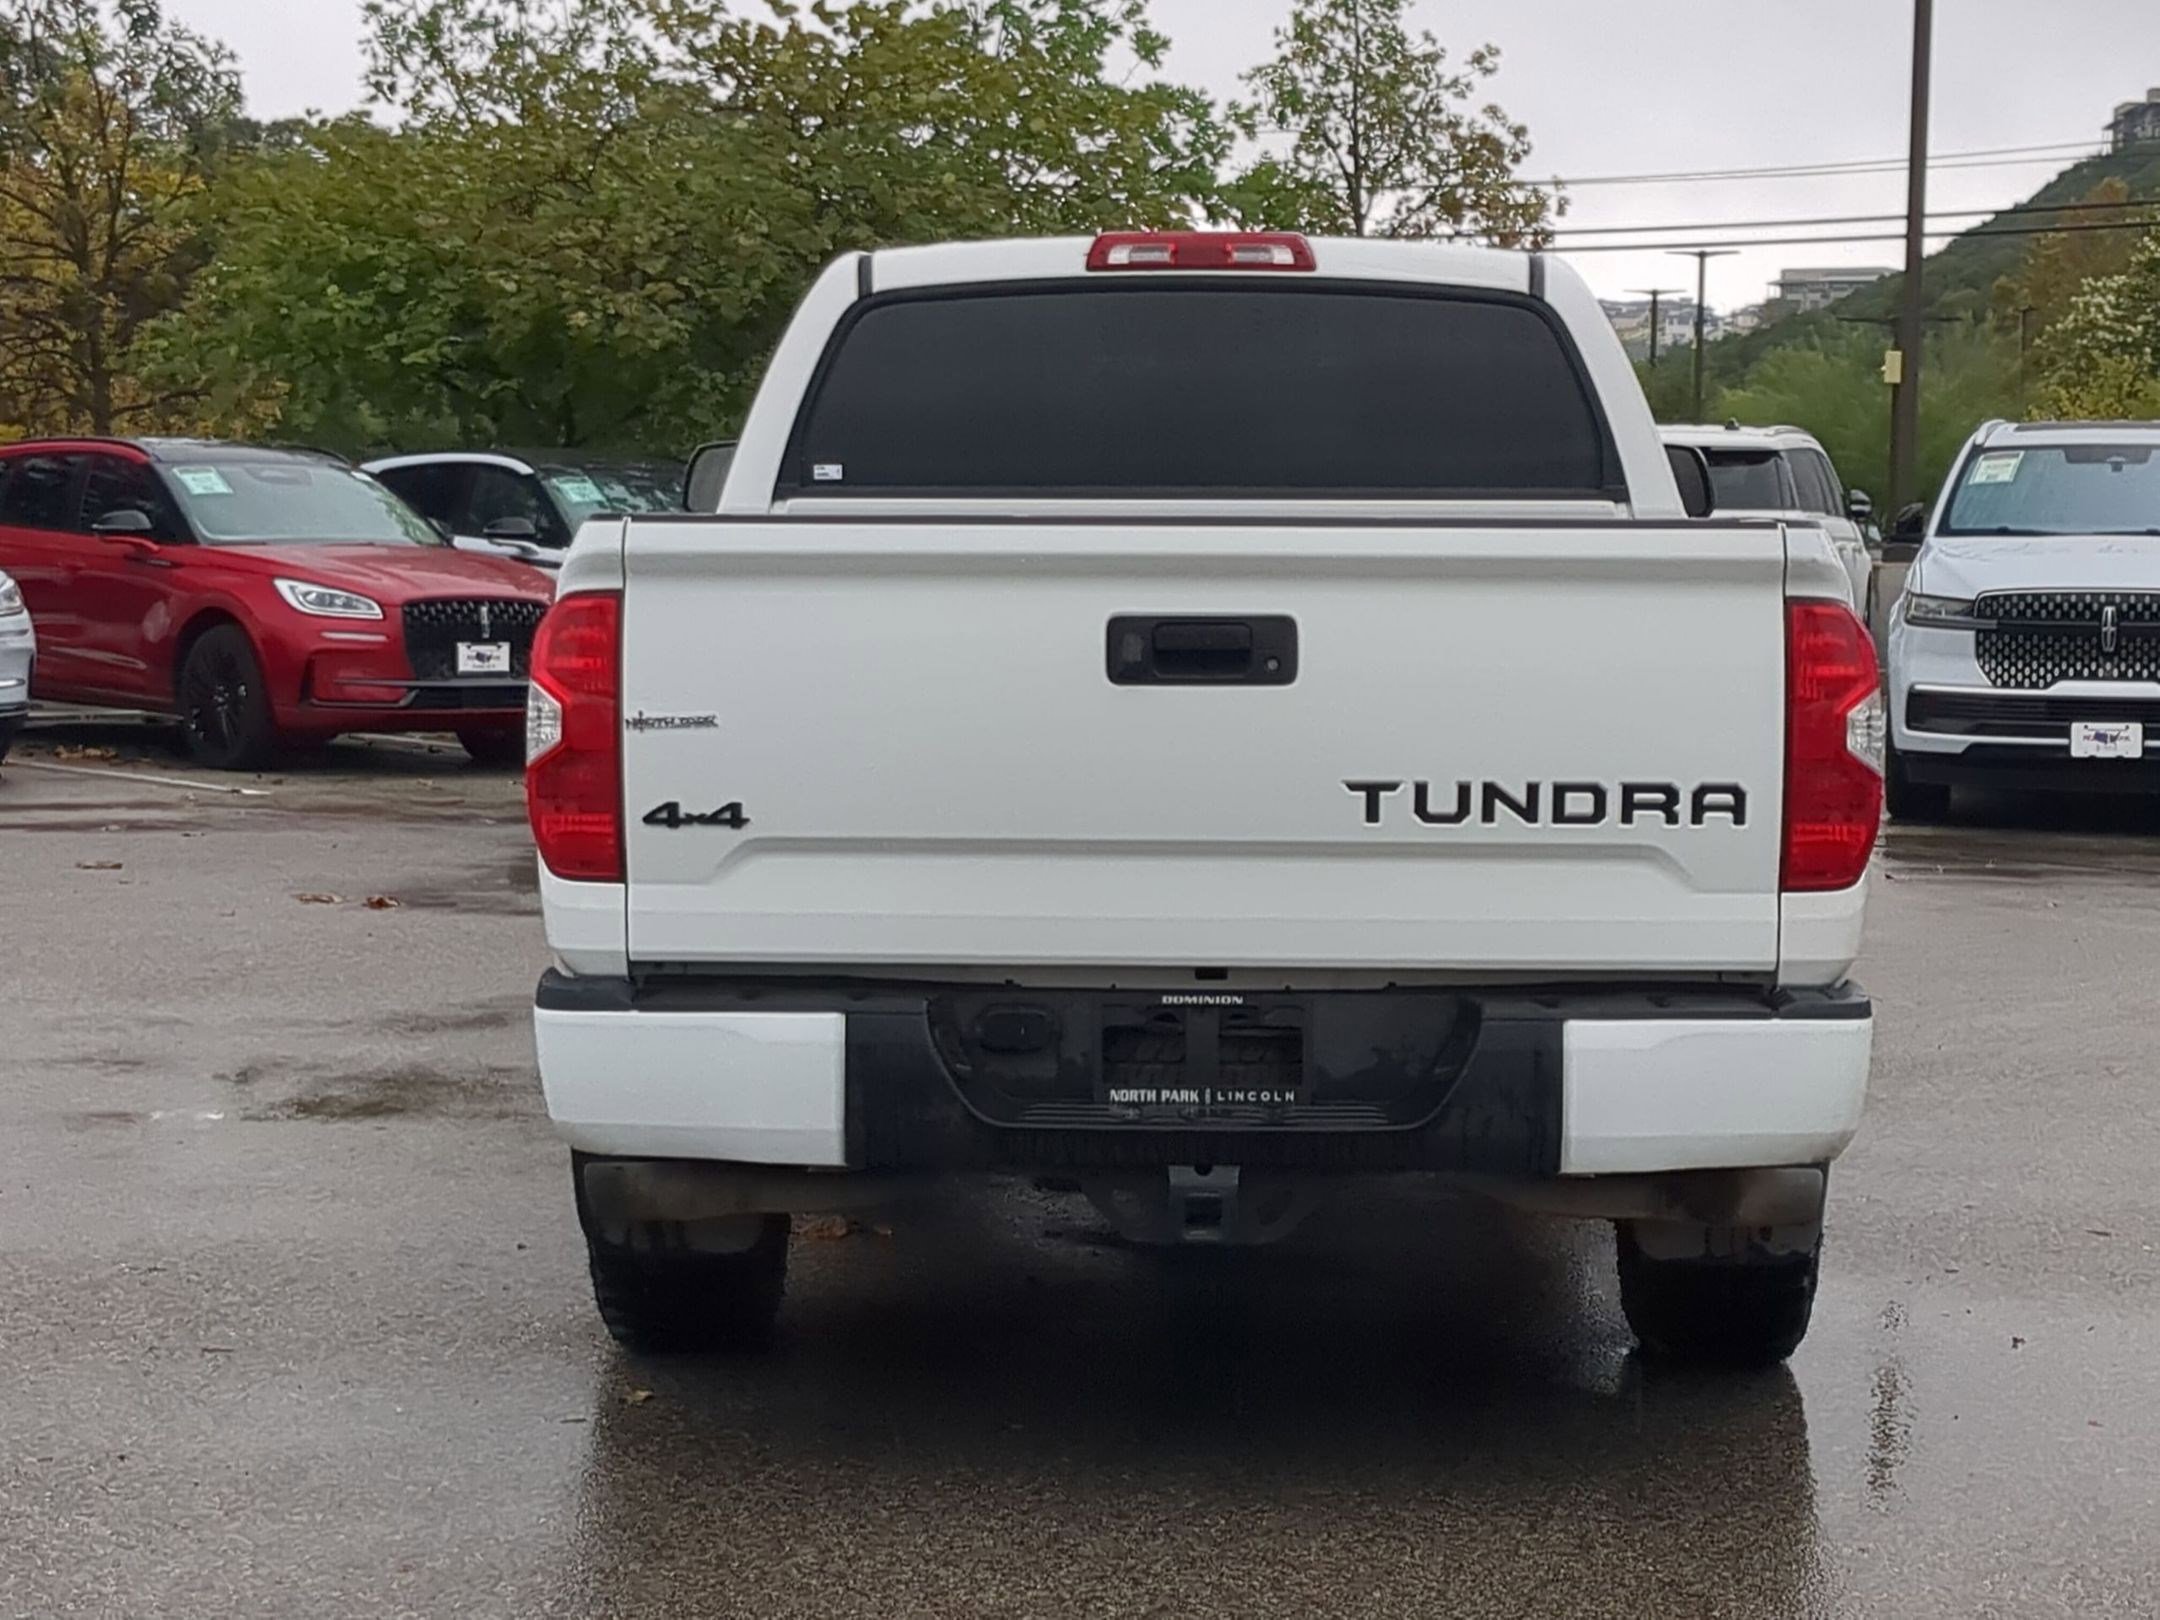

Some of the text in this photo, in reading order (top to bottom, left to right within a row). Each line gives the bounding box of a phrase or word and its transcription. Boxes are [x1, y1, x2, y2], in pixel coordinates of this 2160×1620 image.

[1341, 779, 1747, 826] TUNDRA
[642, 801, 751, 829] 4x4
[1161, 995, 1244, 1005] DOMINION
[1110, 1089, 1295, 1103] NORTH PARK LINCOLN
